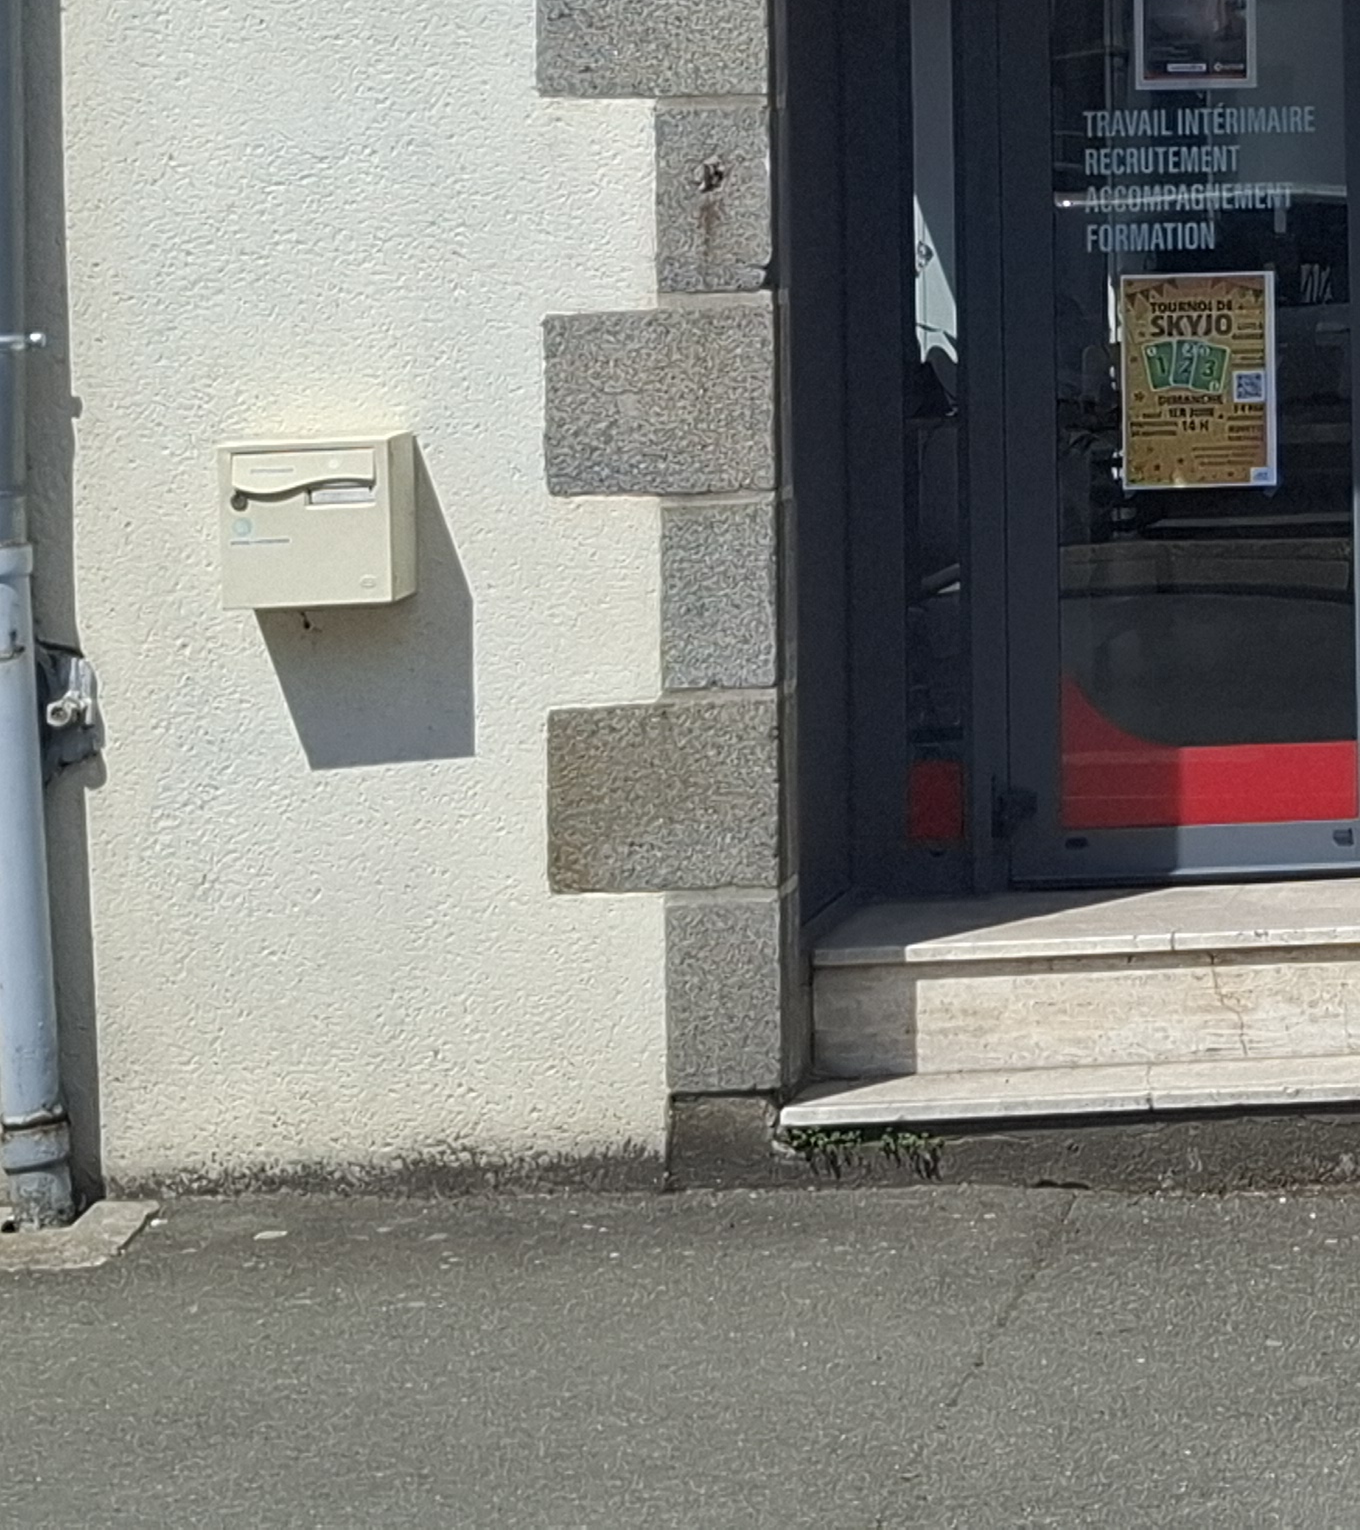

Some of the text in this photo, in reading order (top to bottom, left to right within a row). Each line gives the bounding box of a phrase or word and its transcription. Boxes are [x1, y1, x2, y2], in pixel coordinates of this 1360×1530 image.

[1083, 102, 1316, 137] TRAVAIL INTÉRIMAIRE
[1084, 145, 1240, 175] RECRUTEMENT
[1085, 182, 1293, 213] ACCOMPAGNEMENT
[1087, 221, 1216, 253] FORMATION
[1150, 300, 1212, 313] TOURNOI
[1150, 314, 1233, 337] SKYJO
